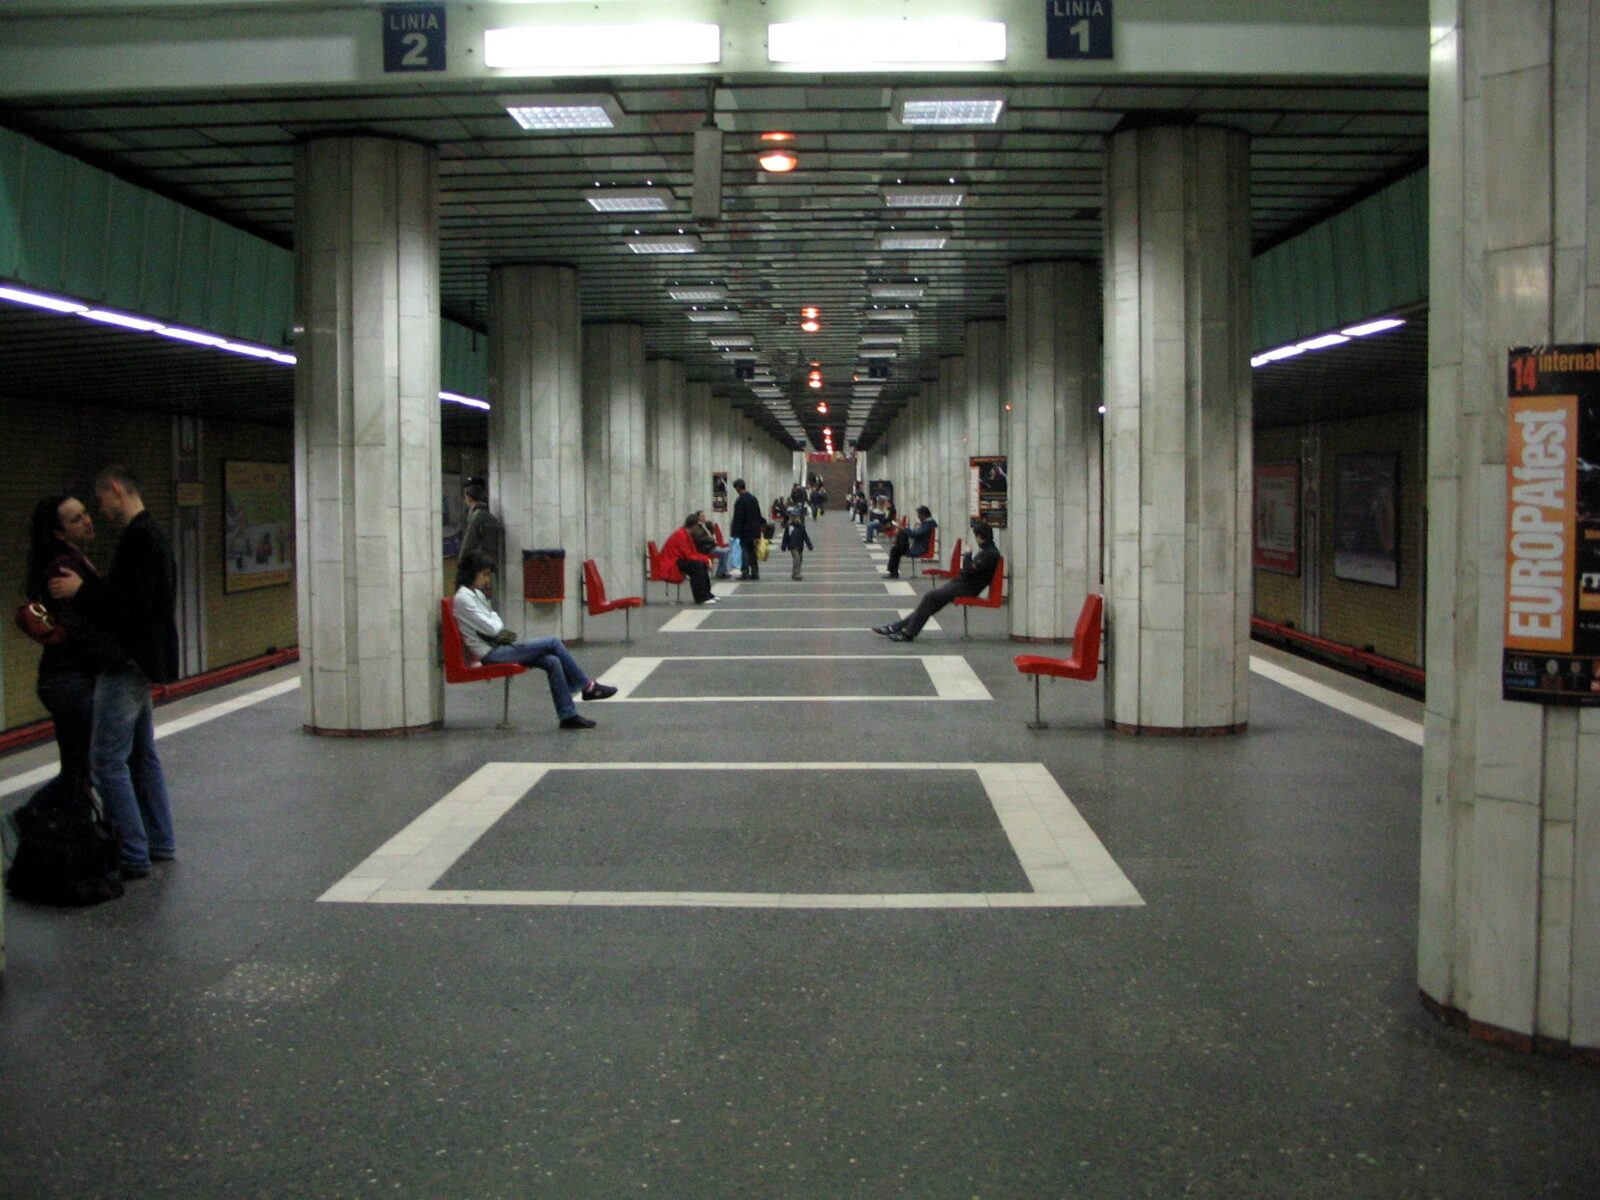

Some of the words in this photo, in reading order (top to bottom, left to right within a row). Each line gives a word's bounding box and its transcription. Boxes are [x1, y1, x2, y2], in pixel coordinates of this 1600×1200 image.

[390, 13, 439, 29] LINIA
[1054, 0, 1104, 16] LINIA
[401, 32, 428, 65] 2
[1070, 19, 1089, 52] 1
[1512, 356, 1537, 391] 14
[1508, 409, 1567, 639] EUROPAfest
